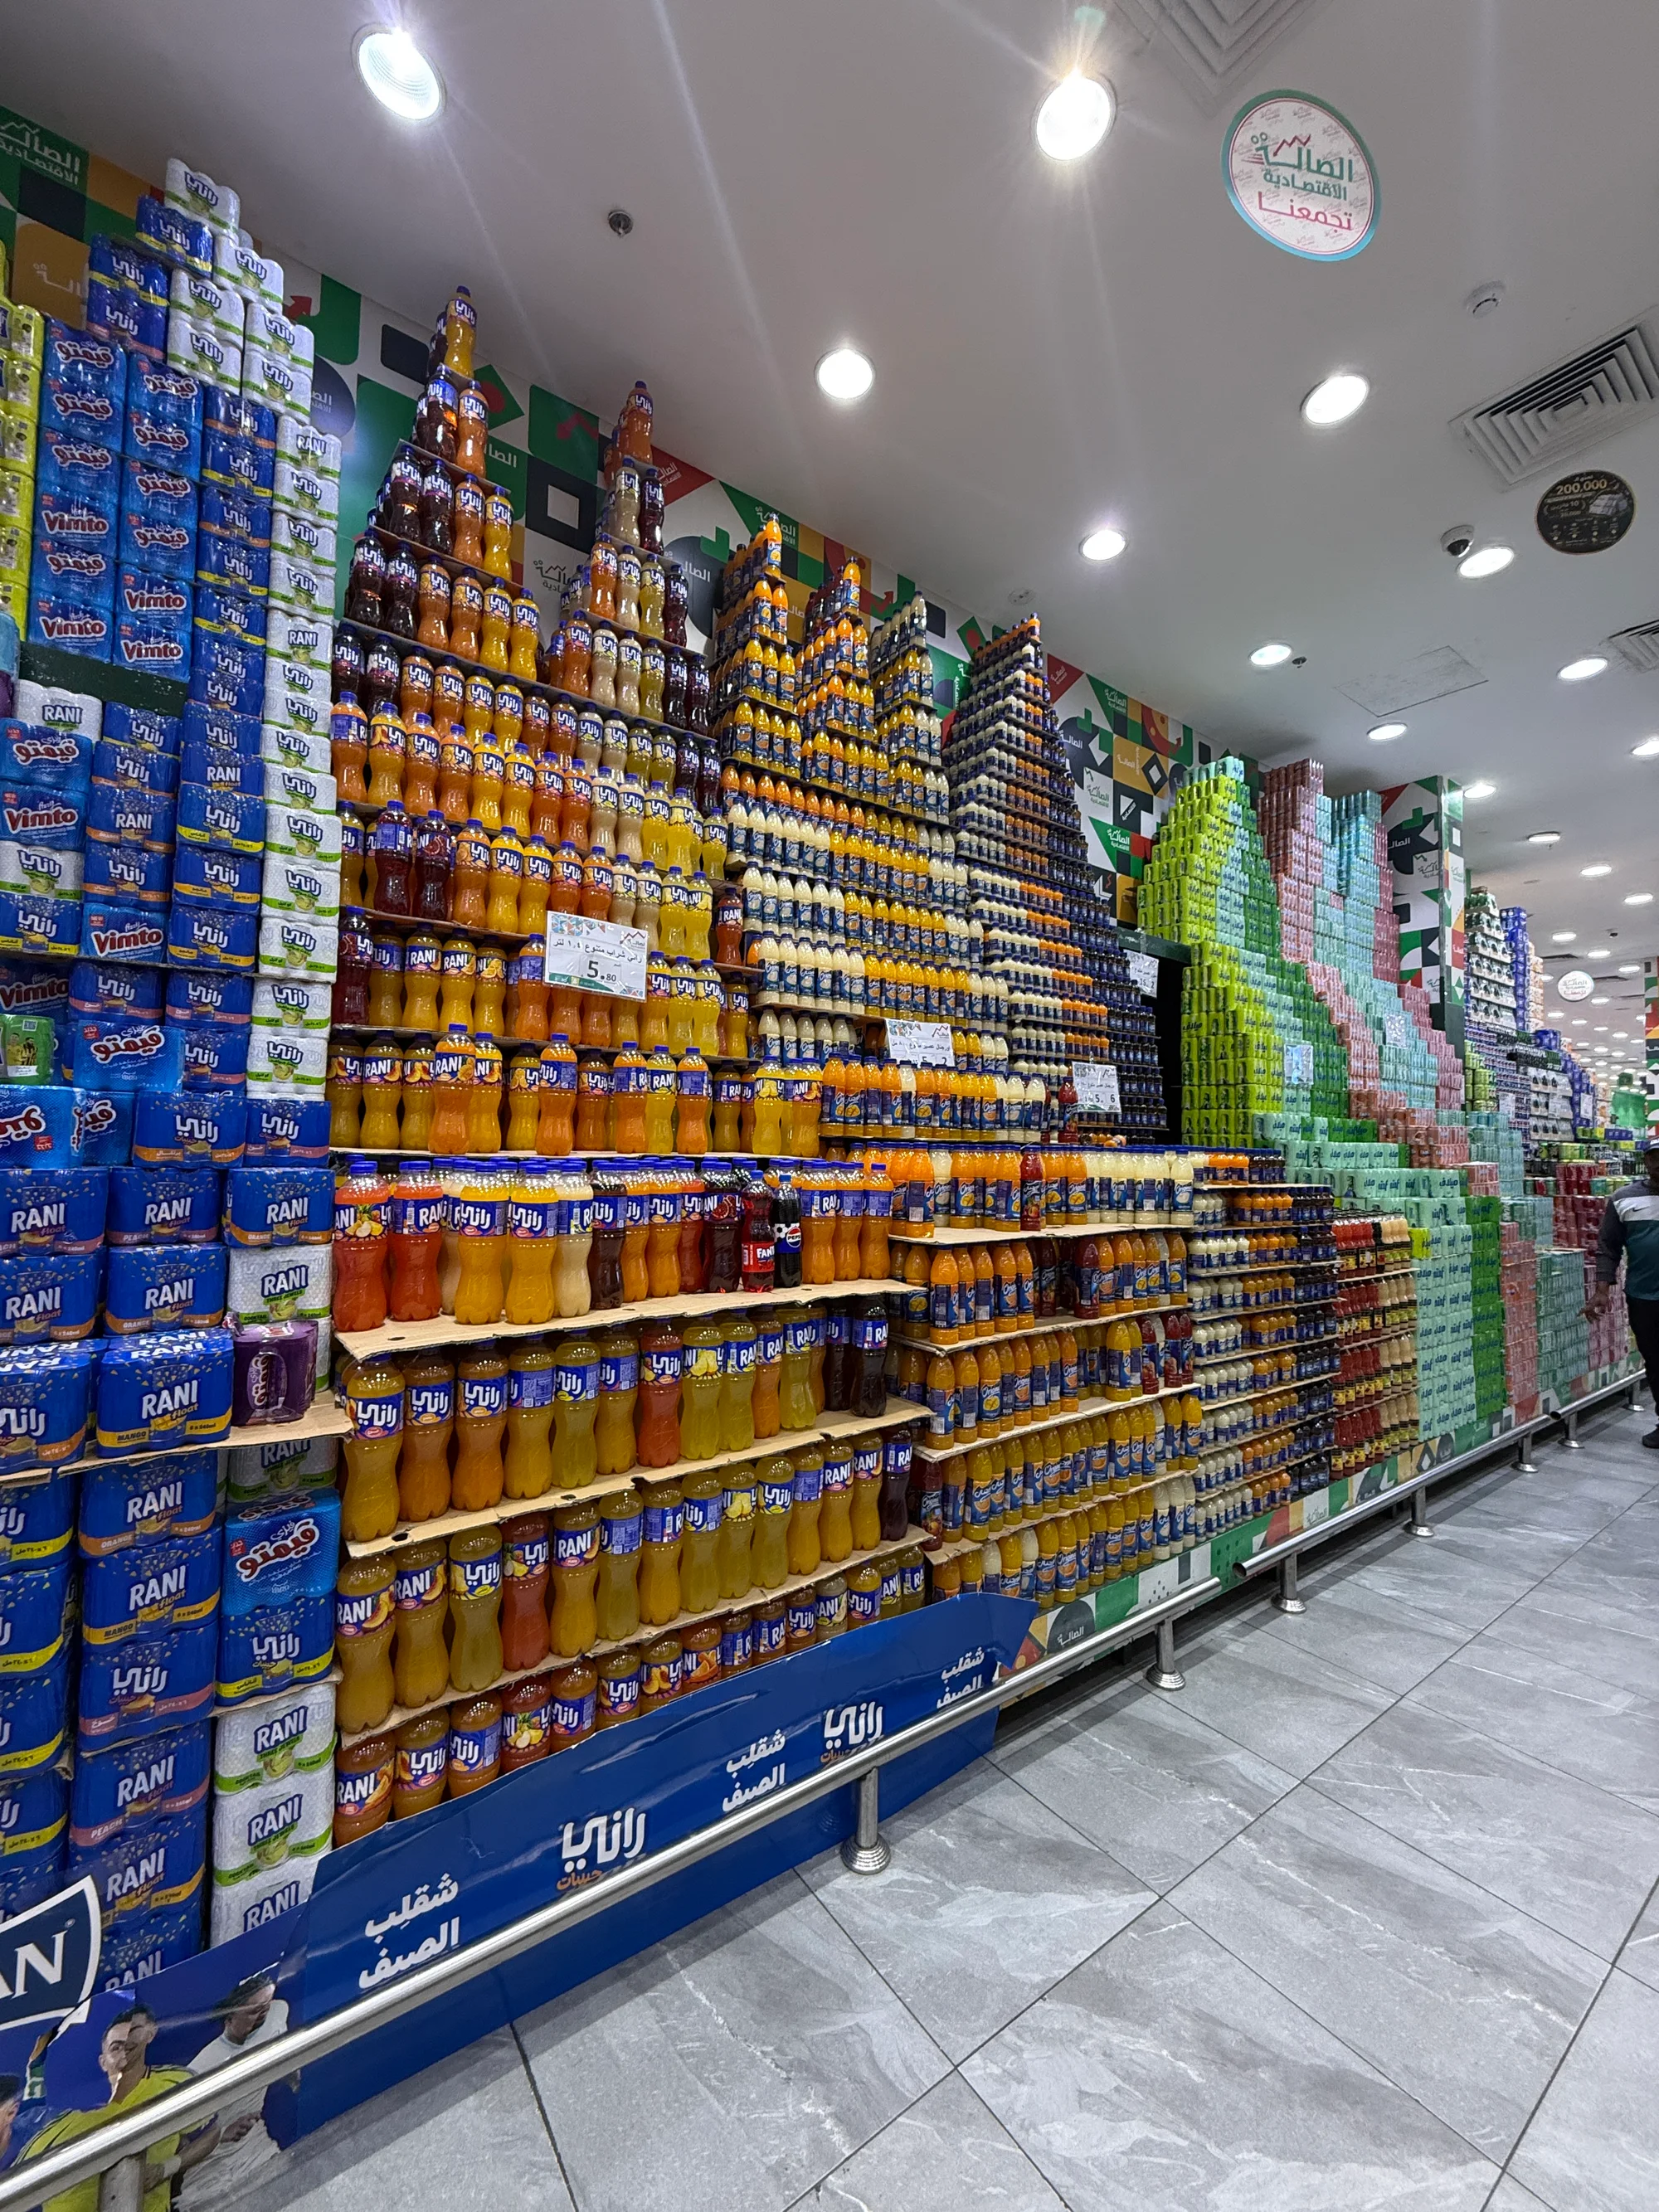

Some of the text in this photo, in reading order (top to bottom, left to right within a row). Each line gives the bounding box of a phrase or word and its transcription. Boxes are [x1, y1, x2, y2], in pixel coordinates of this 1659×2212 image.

[185, 171, 217, 206] راني
[1263, 168, 1346, 201] الاقتصادية
[1258, 192, 1352, 232] تجمعنا
[236, 250, 267, 280] راني
[265, 315, 294, 345] راني
[297, 435, 325, 455] RANI
[230, 454, 257, 481] راني
[42, 510, 109, 533] Vimto
[225, 555, 252, 580] راني
[124, 591, 186, 611] Vimto
[41, 617, 105, 639] Vimto
[217, 654, 246, 679] راني
[207, 680, 237, 707] راني
[43, 705, 81, 724] RANI
[286, 698, 317, 722] راني
[581, 721, 599, 738] راني
[415, 735, 438, 757] راني
[207, 766, 241, 782] RANI
[4, 808, 77, 831] Vimto
[287, 814, 323, 843] راني
[498, 849, 520, 870] راني
[204, 862, 240, 887] راني
[17, 911, 56, 937] راني
[723, 910, 742, 923] RANI
[92, 930, 162, 956] Vimto
[282, 926, 316, 950] راني
[411, 950, 435, 965] RANI
[607, 949, 625, 958] شراب
[2, 980, 68, 1009] Vimto
[272, 984, 309, 1009] راني
[185, 1043, 219, 1067] راني
[435, 1056, 462, 1073] RANI
[653, 1071, 676, 1087] RANI
[176, 1115, 218, 1143] راني
[11, 1202, 66, 1232] RANI
[145, 1198, 192, 1224] RANI
[461, 1203, 490, 1228] راني
[757, 1246, 775, 1258] FANT
[264, 1266, 307, 1296] RANI
[6, 1286, 61, 1320] RANI
[654, 1354, 681, 1376] راني
[171, 1403, 198, 1419] float
[357, 1403, 397, 1427] راني
[118, 1432, 146, 1441] MANGO
[127, 1481, 182, 1523] RANI
[101, 1534, 133, 1548] ORANGE
[557, 1531, 591, 1558] RANI
[396, 1572, 431, 1599] RANI
[466, 1563, 500, 1585] راني
[104, 1622, 134, 1638] MANGO
[252, 1634, 300, 1659] راني
[255, 1708, 307, 1753] RANI
[823, 1701, 883, 1750] راني
[411, 1748, 446, 1775] راني
[337, 1773, 377, 1804] RANI
[90, 1818, 124, 1839] PEACH
[248, 1794, 302, 1846] RANI
[558, 1807, 646, 1873] راني
[244, 1881, 299, 1932] RANI
